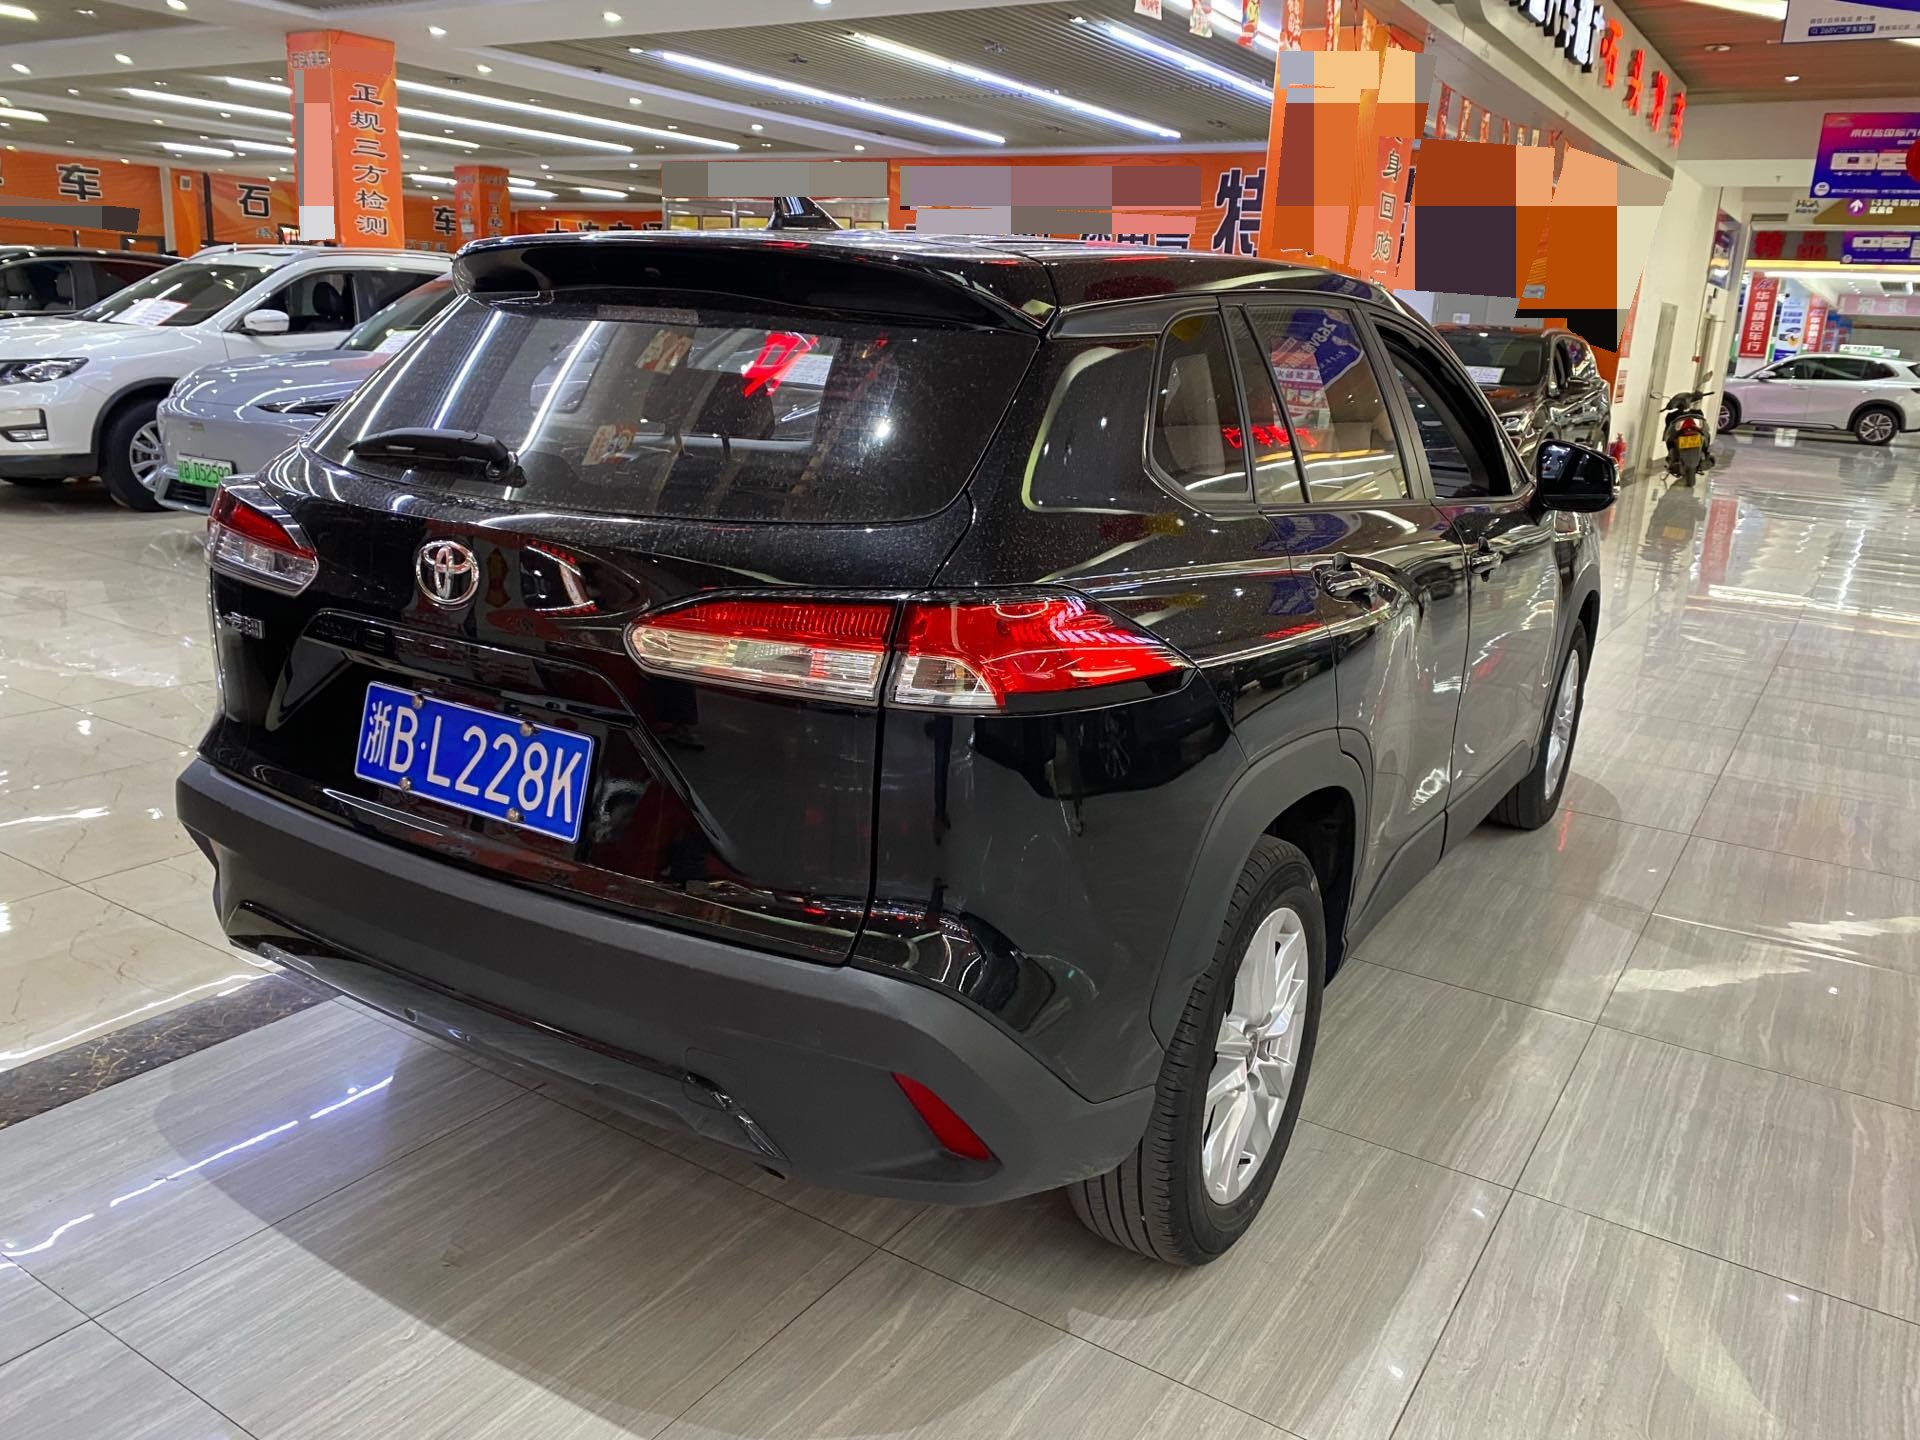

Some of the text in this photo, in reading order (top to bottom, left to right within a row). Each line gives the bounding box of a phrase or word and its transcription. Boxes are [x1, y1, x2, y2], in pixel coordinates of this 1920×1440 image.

[57, 163, 102, 201] 车
[348, 82, 390, 237] 正规三方检测
[238, 183, 271, 218] 石
[363, 700, 582, 824] 浙B·L228K
